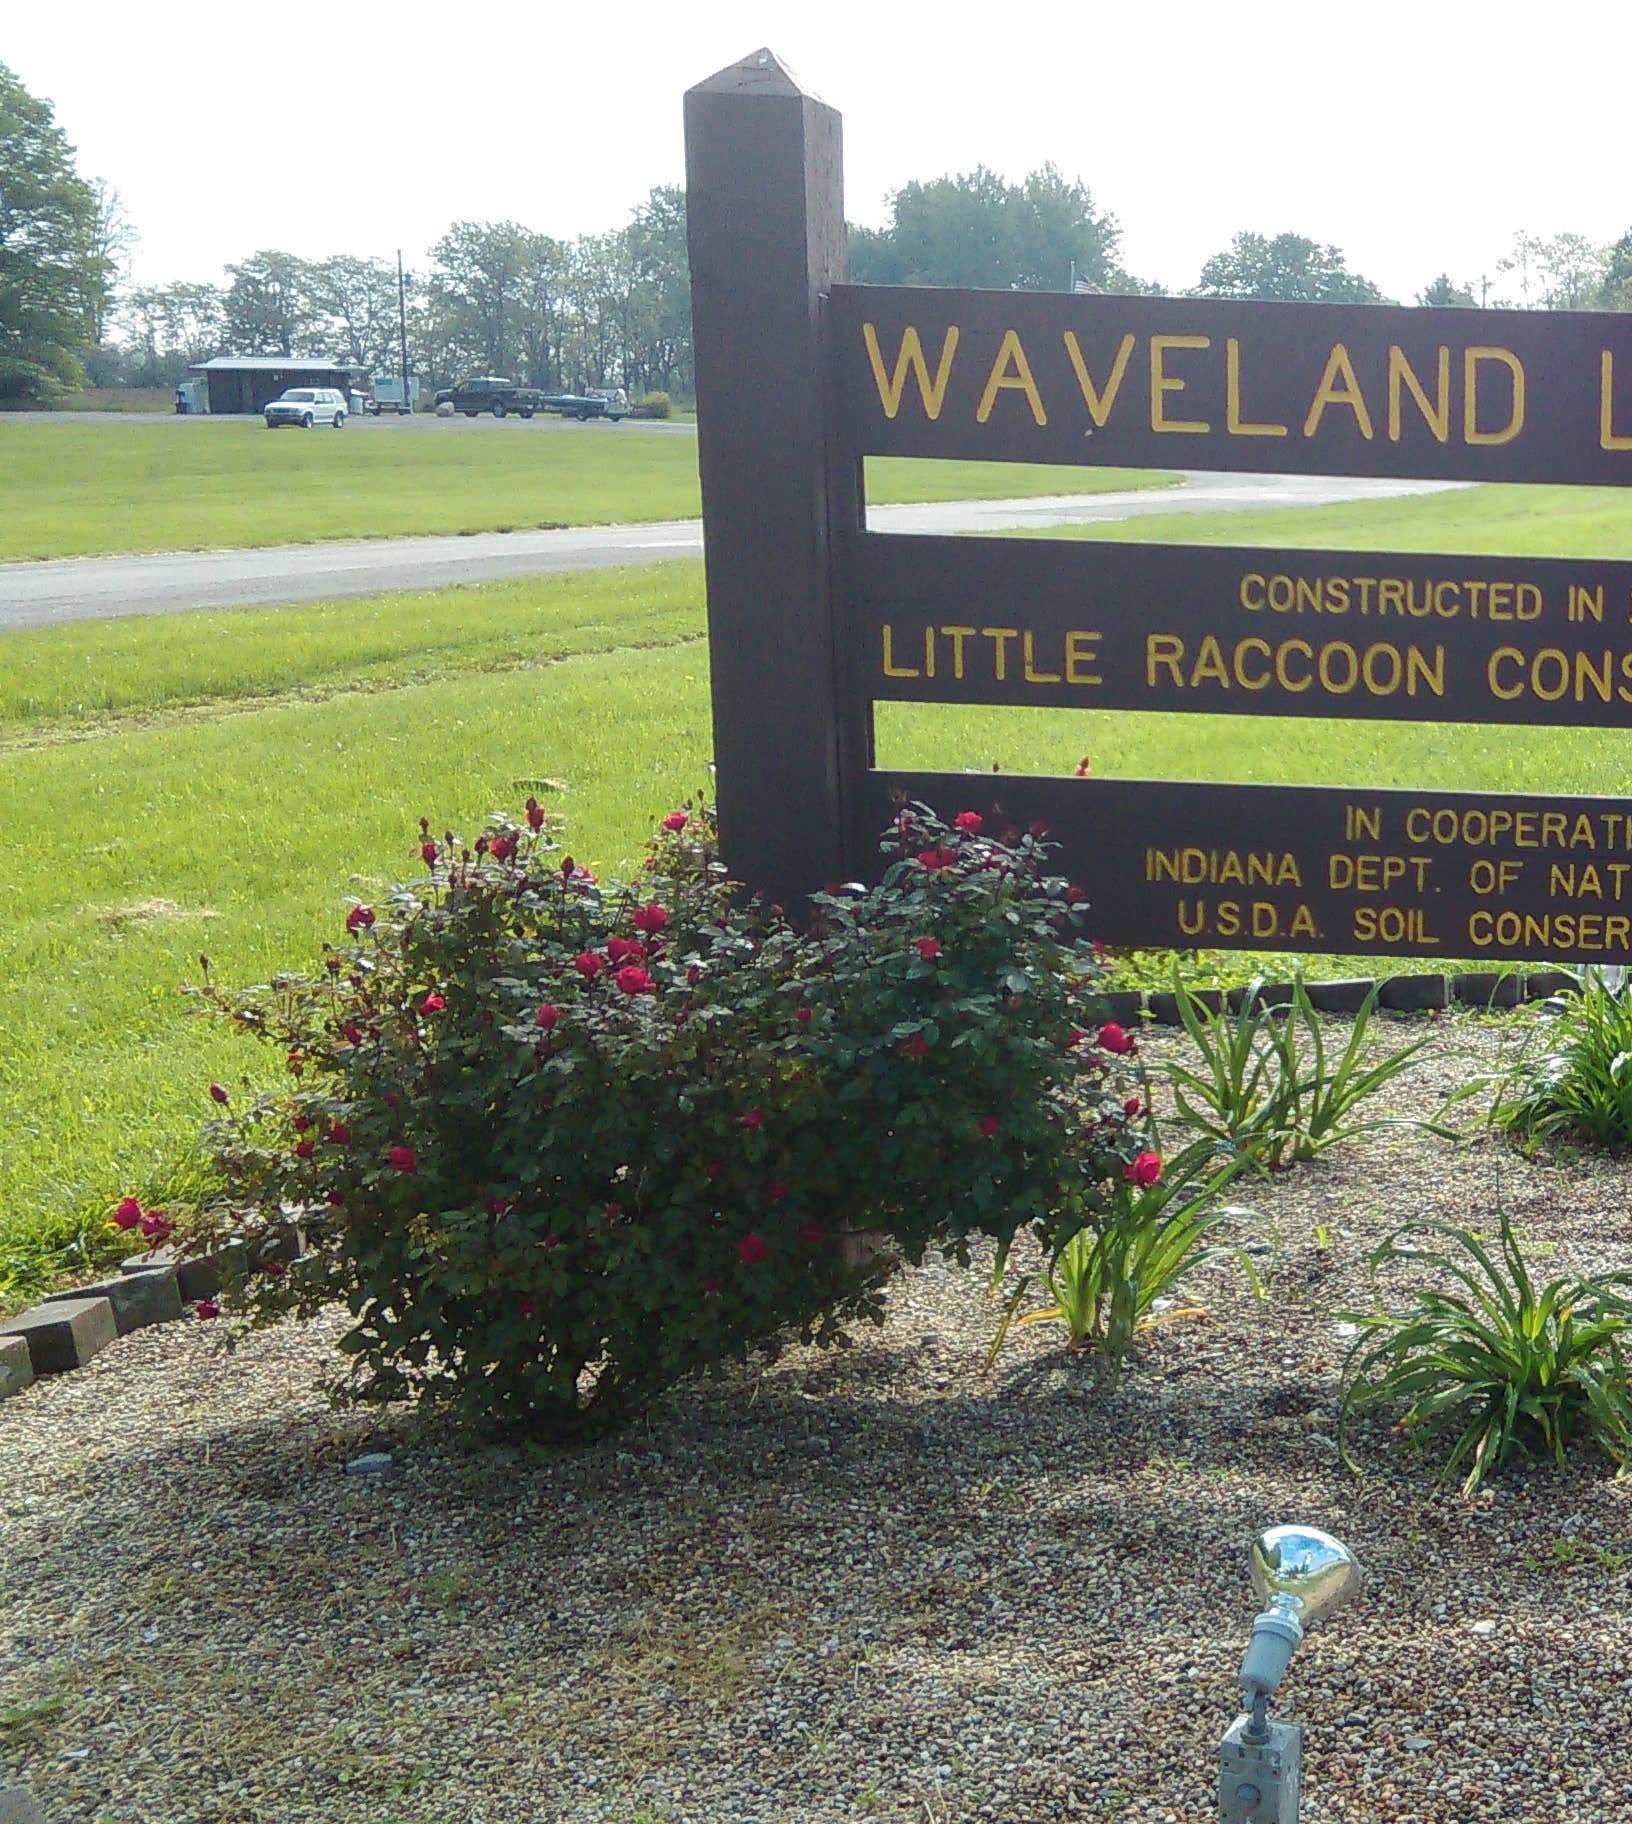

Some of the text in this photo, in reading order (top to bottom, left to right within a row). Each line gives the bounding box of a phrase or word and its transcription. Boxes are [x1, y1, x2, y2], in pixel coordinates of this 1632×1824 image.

[862, 323, 1526, 446] WAVELAND
[1239, 573, 1544, 622] CONSTRUCTED
[1567, 586, 1604, 624] IN
[882, 624, 1103, 686] LITTLE
[1145, 633, 1447, 698] RACCOON
[1345, 805, 1382, 842] IN
[1144, 847, 1303, 889] INDIANA
[1328, 853, 1442, 894] DEPT.
[1469, 860, 1526, 896] OF
[1352, 906, 1441, 945] SOIL
